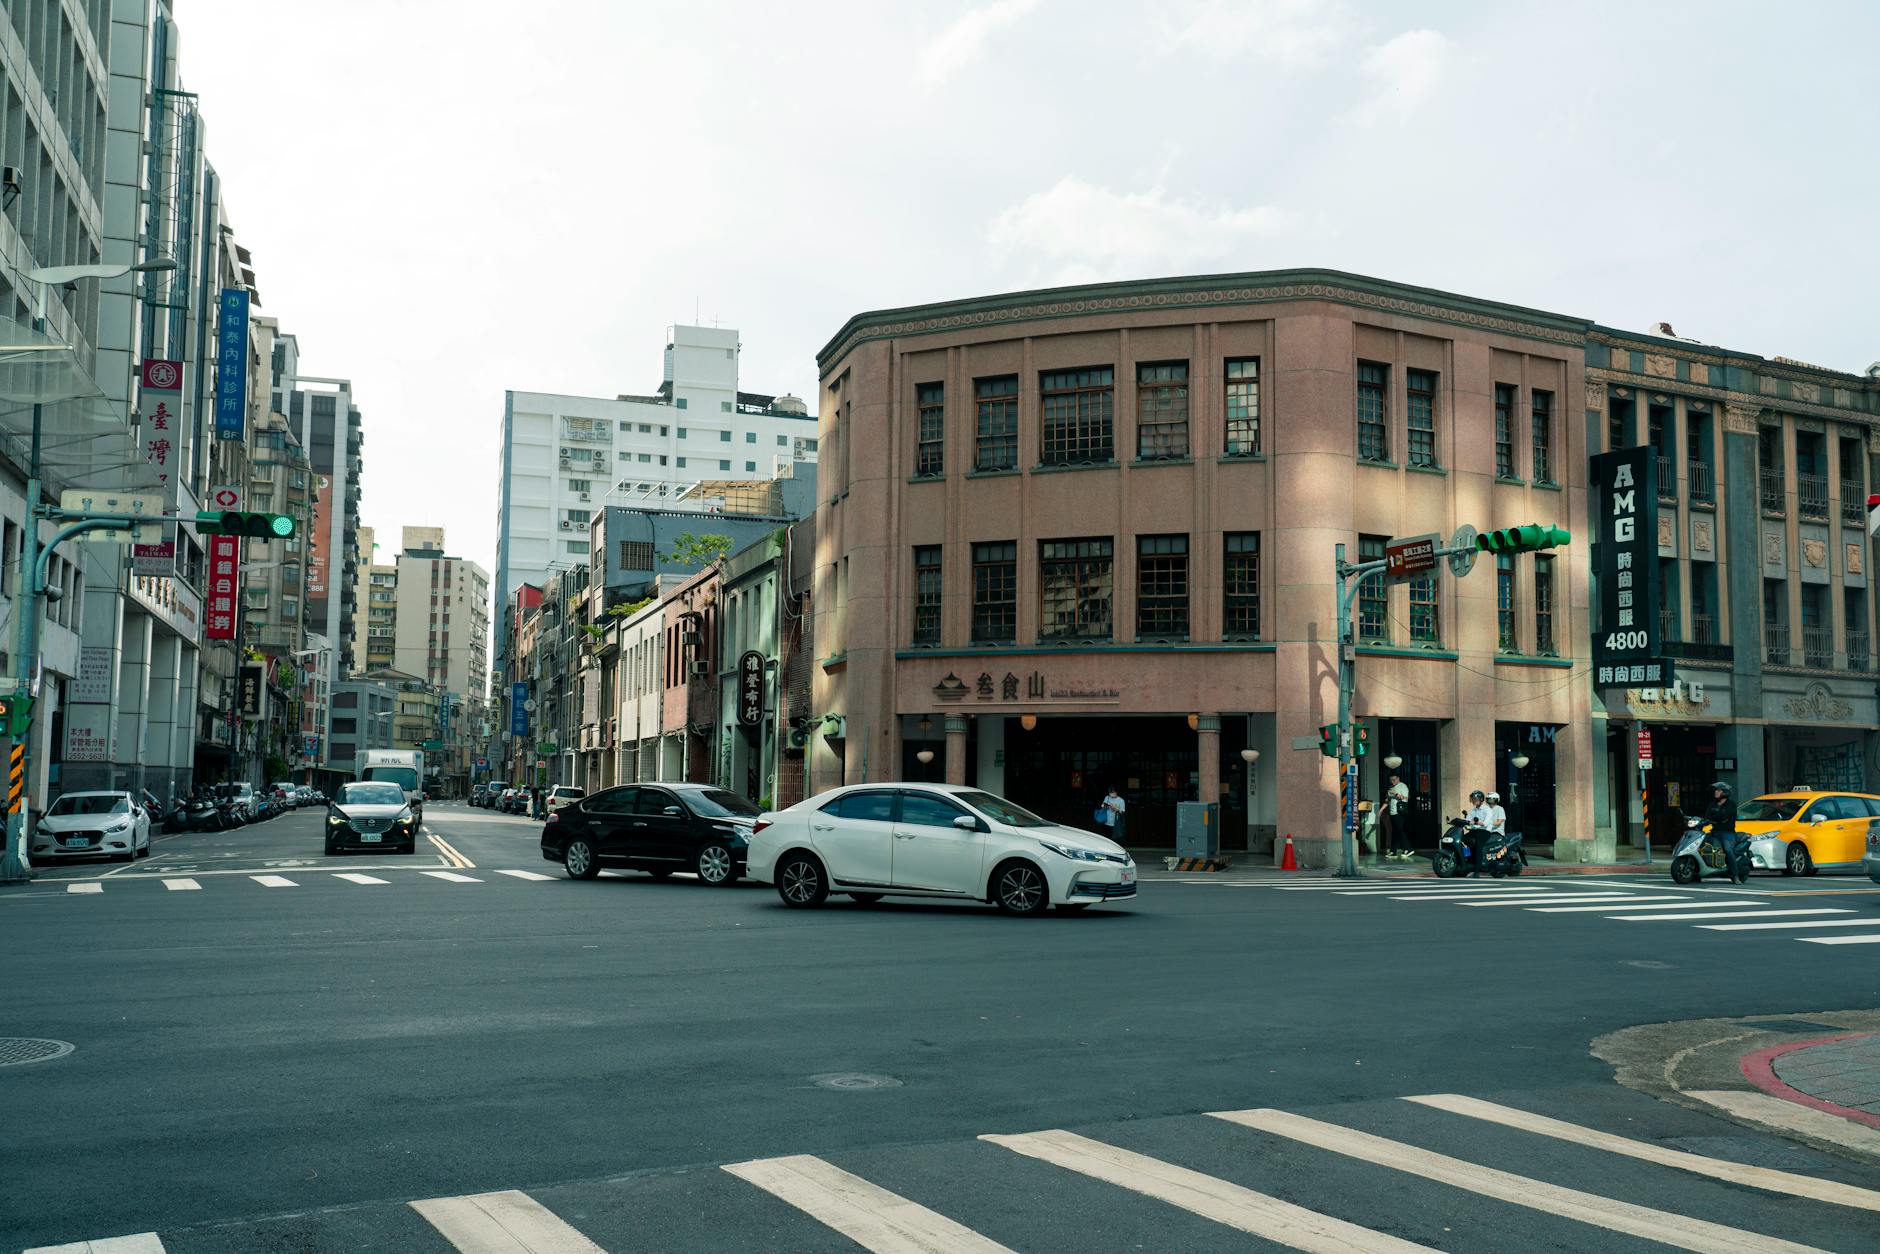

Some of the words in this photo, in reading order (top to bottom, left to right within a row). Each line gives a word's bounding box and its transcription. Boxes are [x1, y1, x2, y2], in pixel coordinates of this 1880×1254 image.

[222, 314, 240, 411] 和泰內科診所
[223, 429, 239, 440] 8F
[1613, 463, 1636, 544] AMG
[214, 534, 233, 630] 和綜合證券
[1616, 551, 1634, 627] 時尚西服
[1599, 664, 1662, 684] 時尚西服
[1605, 630, 1649, 651] 4800
